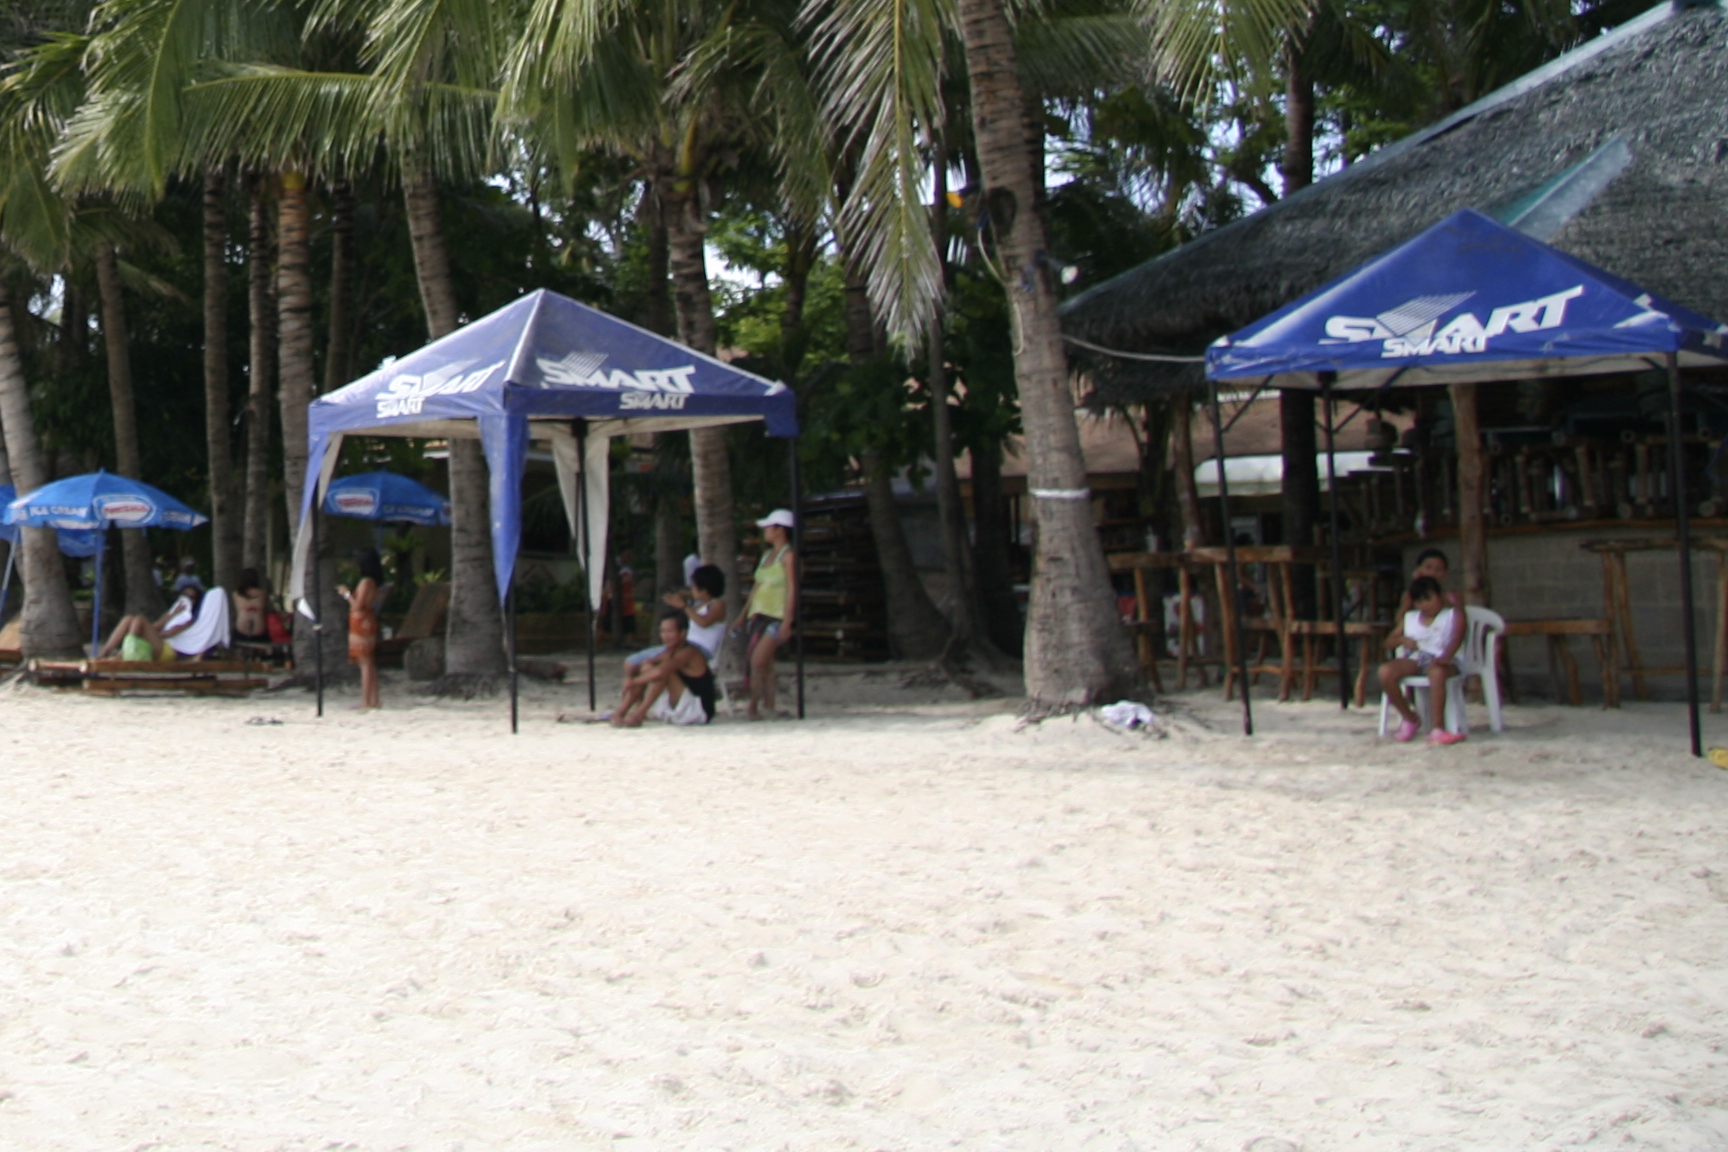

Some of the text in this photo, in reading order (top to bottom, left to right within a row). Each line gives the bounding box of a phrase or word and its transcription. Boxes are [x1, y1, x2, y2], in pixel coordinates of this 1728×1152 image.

[1318, 285, 1584, 345] SMART
[1381, 334, 1487, 358] SMART
[375, 360, 507, 400] SMART
[536, 357, 696, 394] SMART
[376, 398, 425, 418] SMART
[619, 393, 690, 410] SMART
